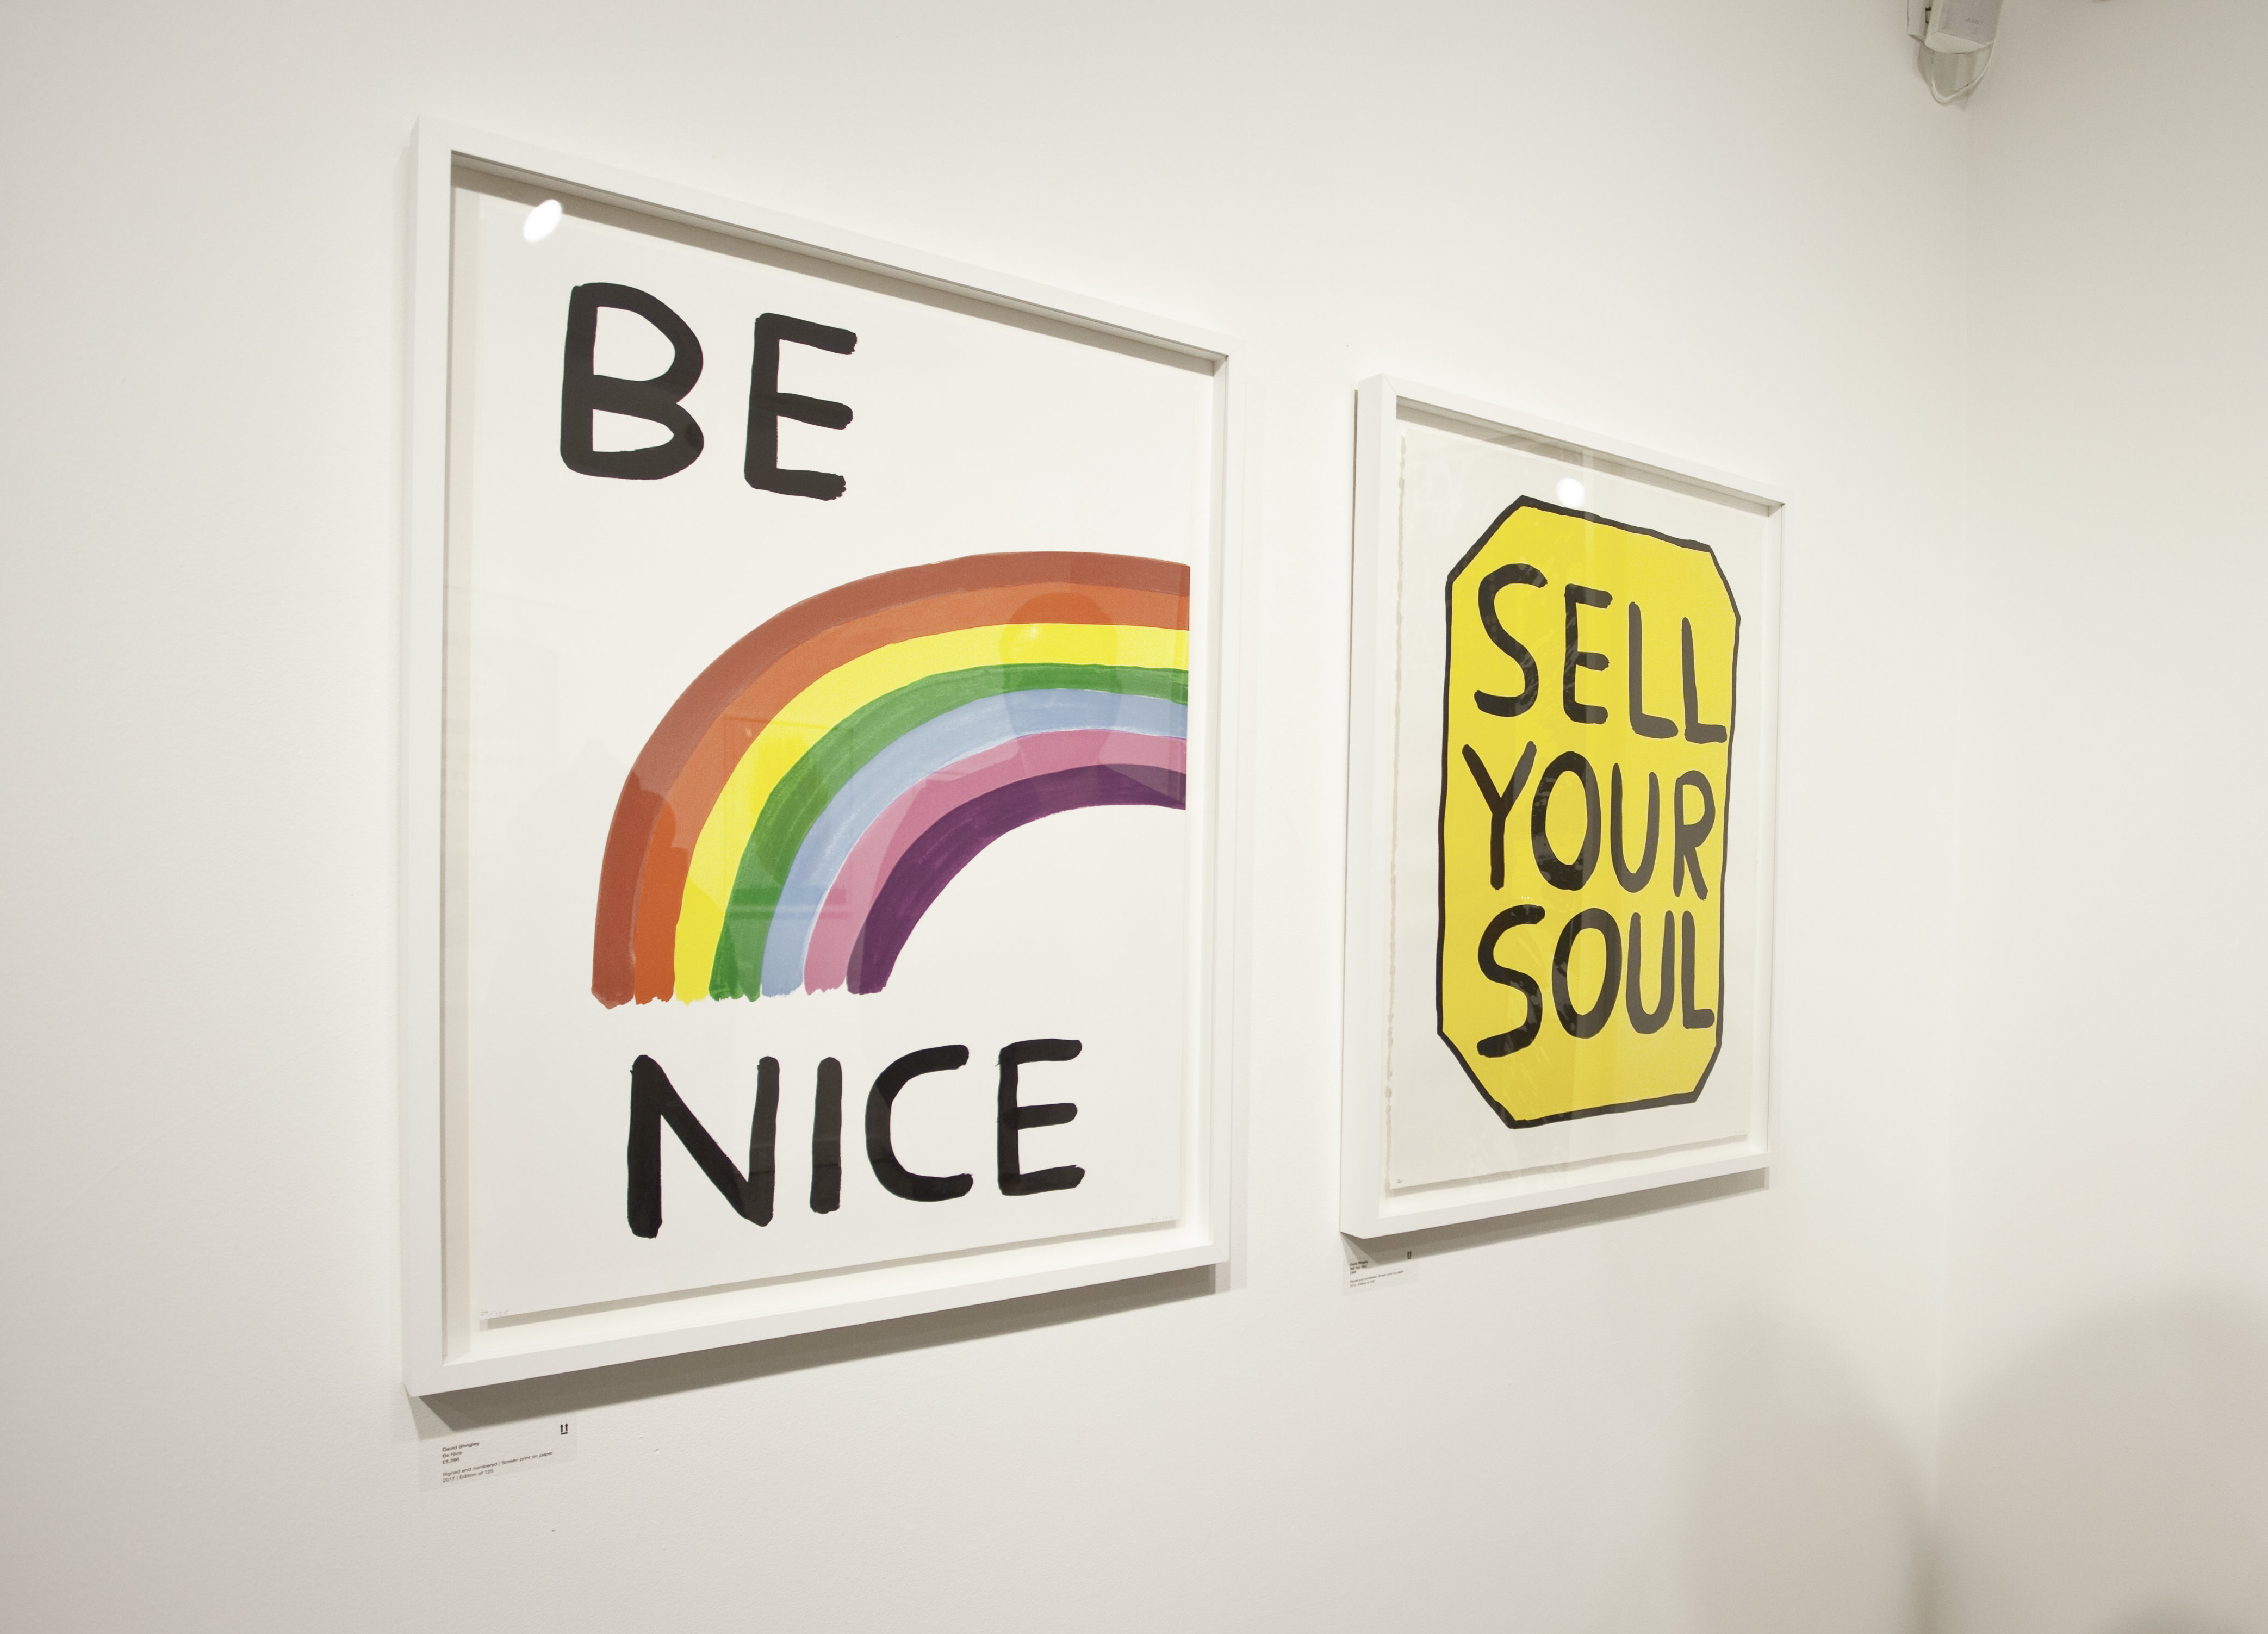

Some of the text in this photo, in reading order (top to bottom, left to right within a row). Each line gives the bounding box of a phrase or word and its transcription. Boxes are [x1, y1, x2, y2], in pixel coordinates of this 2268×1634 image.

[560, 282, 857, 501] BE
[1474, 563, 1728, 743] SELL
[1462, 741, 1716, 900] YOUR
[1476, 904, 1715, 1058] SOUL
[627, 1038, 1085, 1239] NICE
[473, 1462, 498, 1470] numbered
